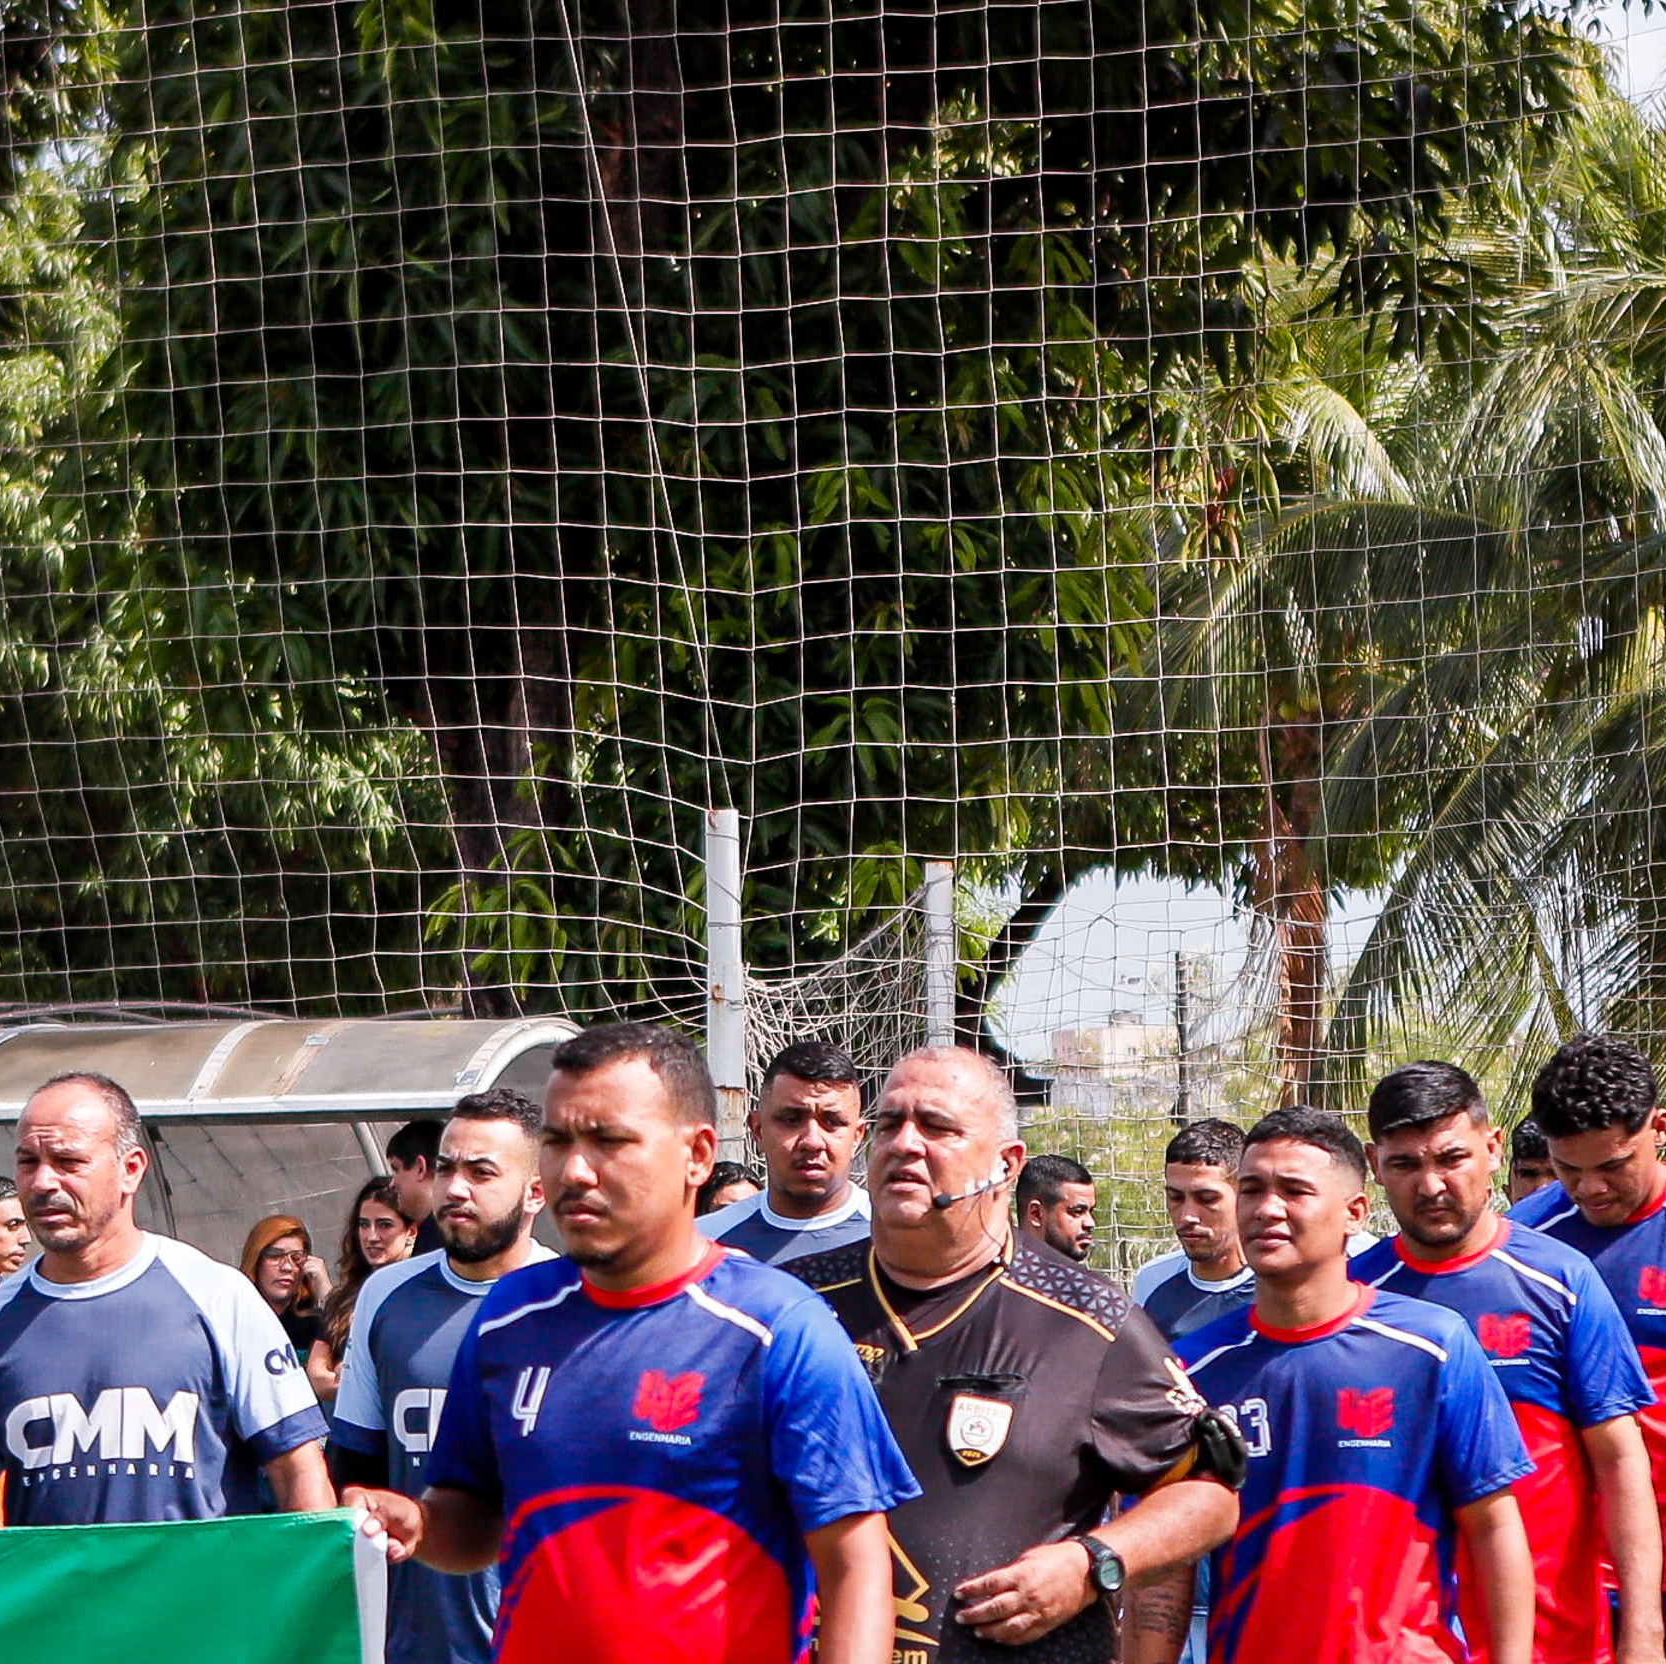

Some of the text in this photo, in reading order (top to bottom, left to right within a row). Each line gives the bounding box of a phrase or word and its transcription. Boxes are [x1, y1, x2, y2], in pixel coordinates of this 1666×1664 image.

[264, 1343, 299, 1375] CM
[512, 1366, 551, 1437] 4
[6, 1387, 199, 1470] CMM
[629, 1430, 692, 1446] ENGENHARIA
[23, 1463, 195, 1487] ENGENHARIA
